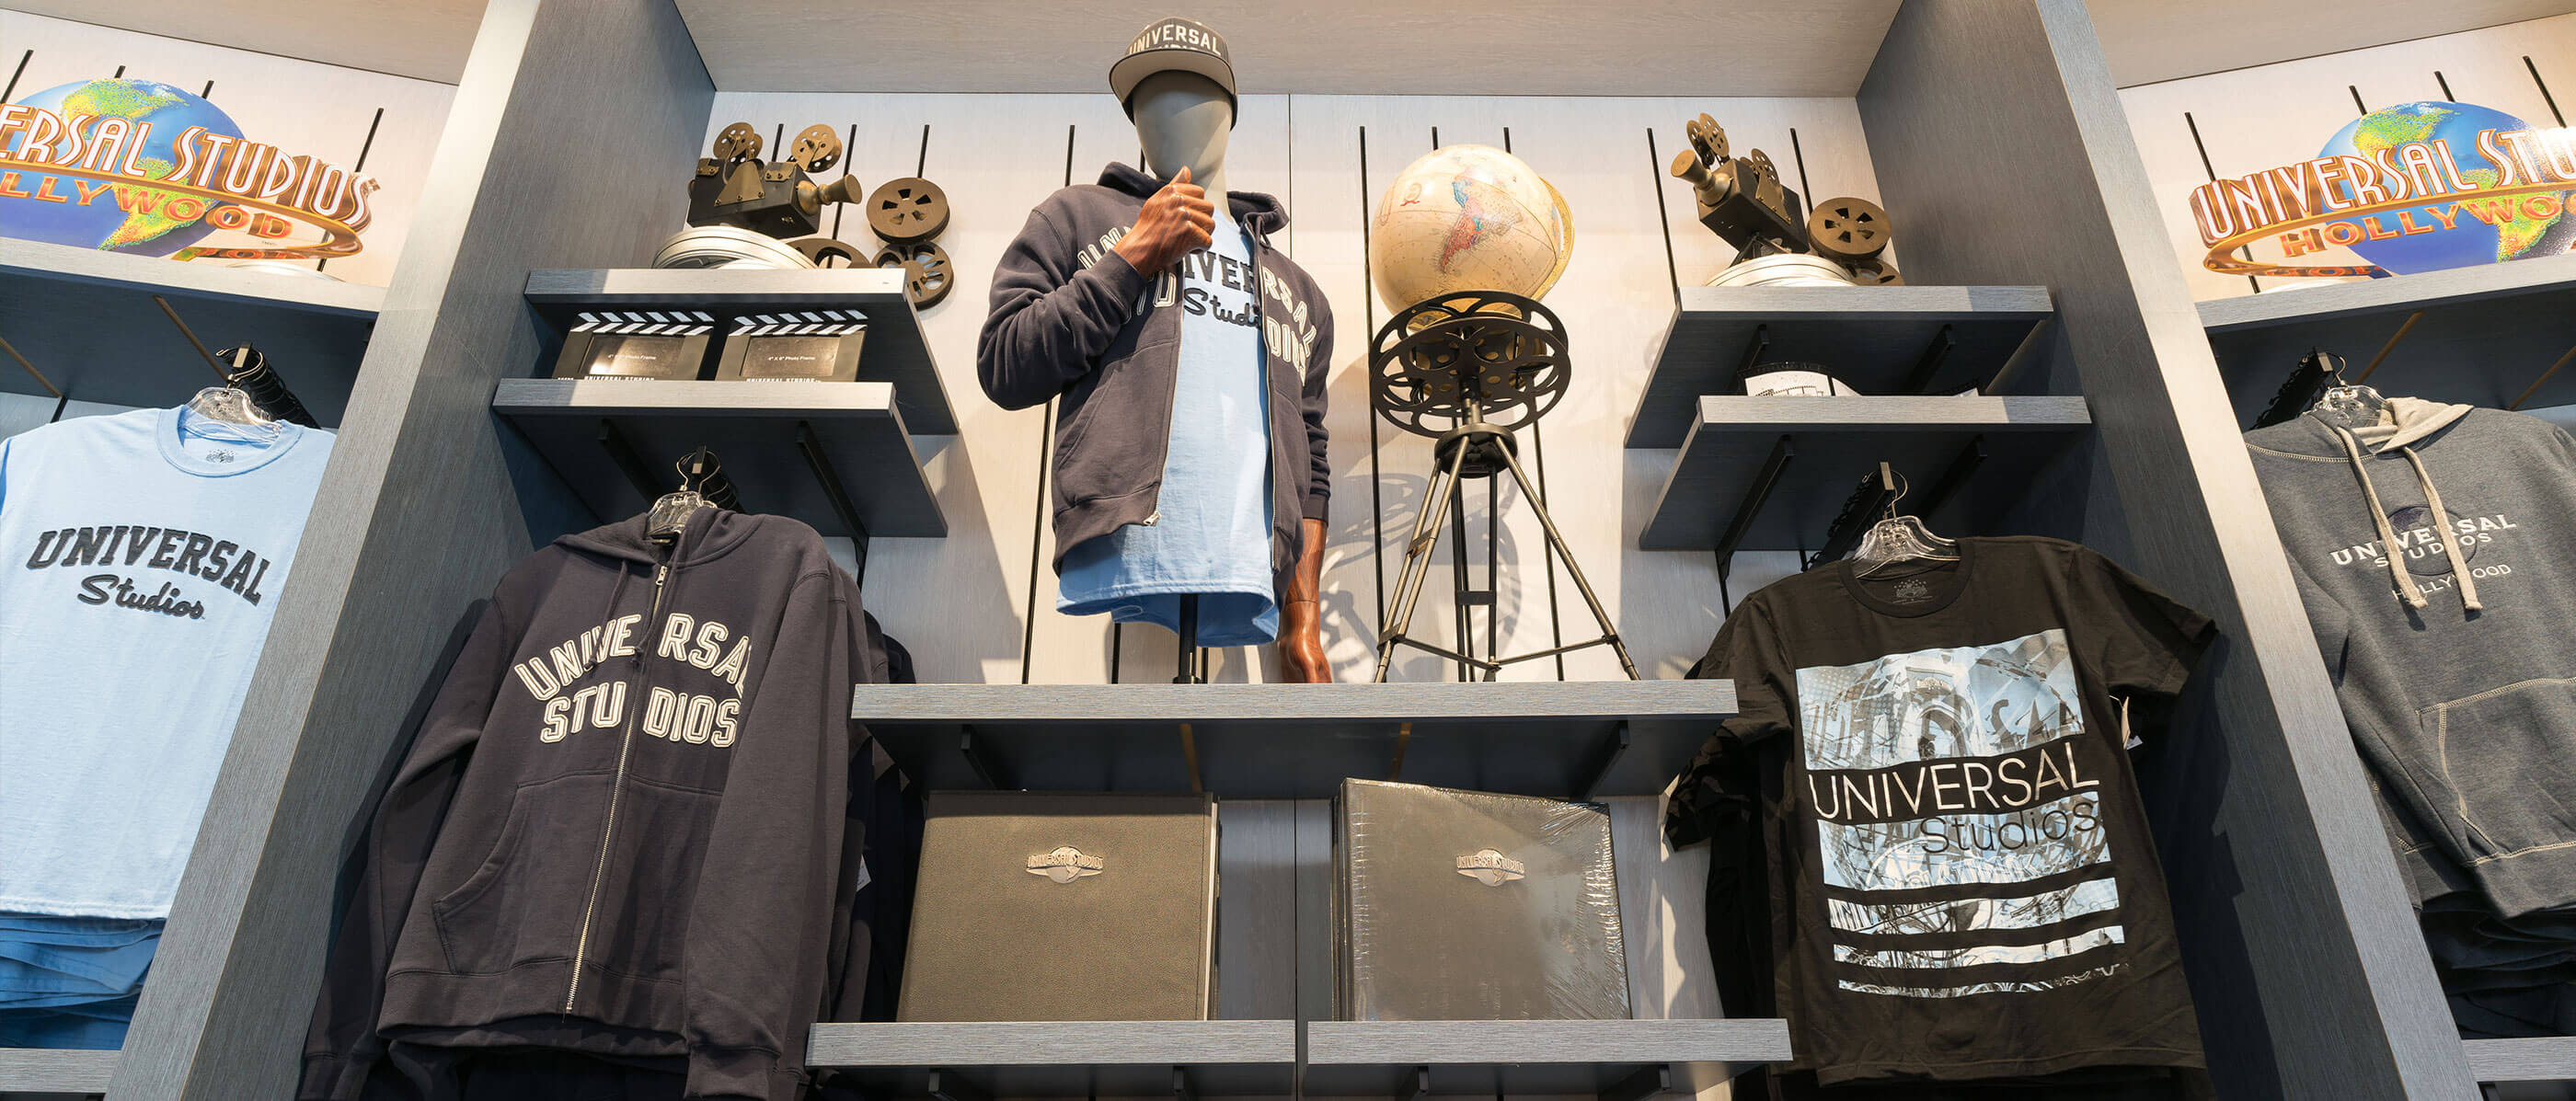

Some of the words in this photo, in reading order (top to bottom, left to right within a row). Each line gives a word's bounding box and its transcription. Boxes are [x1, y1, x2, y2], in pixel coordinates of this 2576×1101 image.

[167, 125, 372, 232] STUDIOS
[2195, 139, 2478, 239] UNIVERSAL
[26, 525, 270, 607] UNIVERSAL
[77, 574, 204, 620] Studios
[1809, 741, 2100, 820] UNIVERSAL
[1920, 802, 2099, 853] Studios
